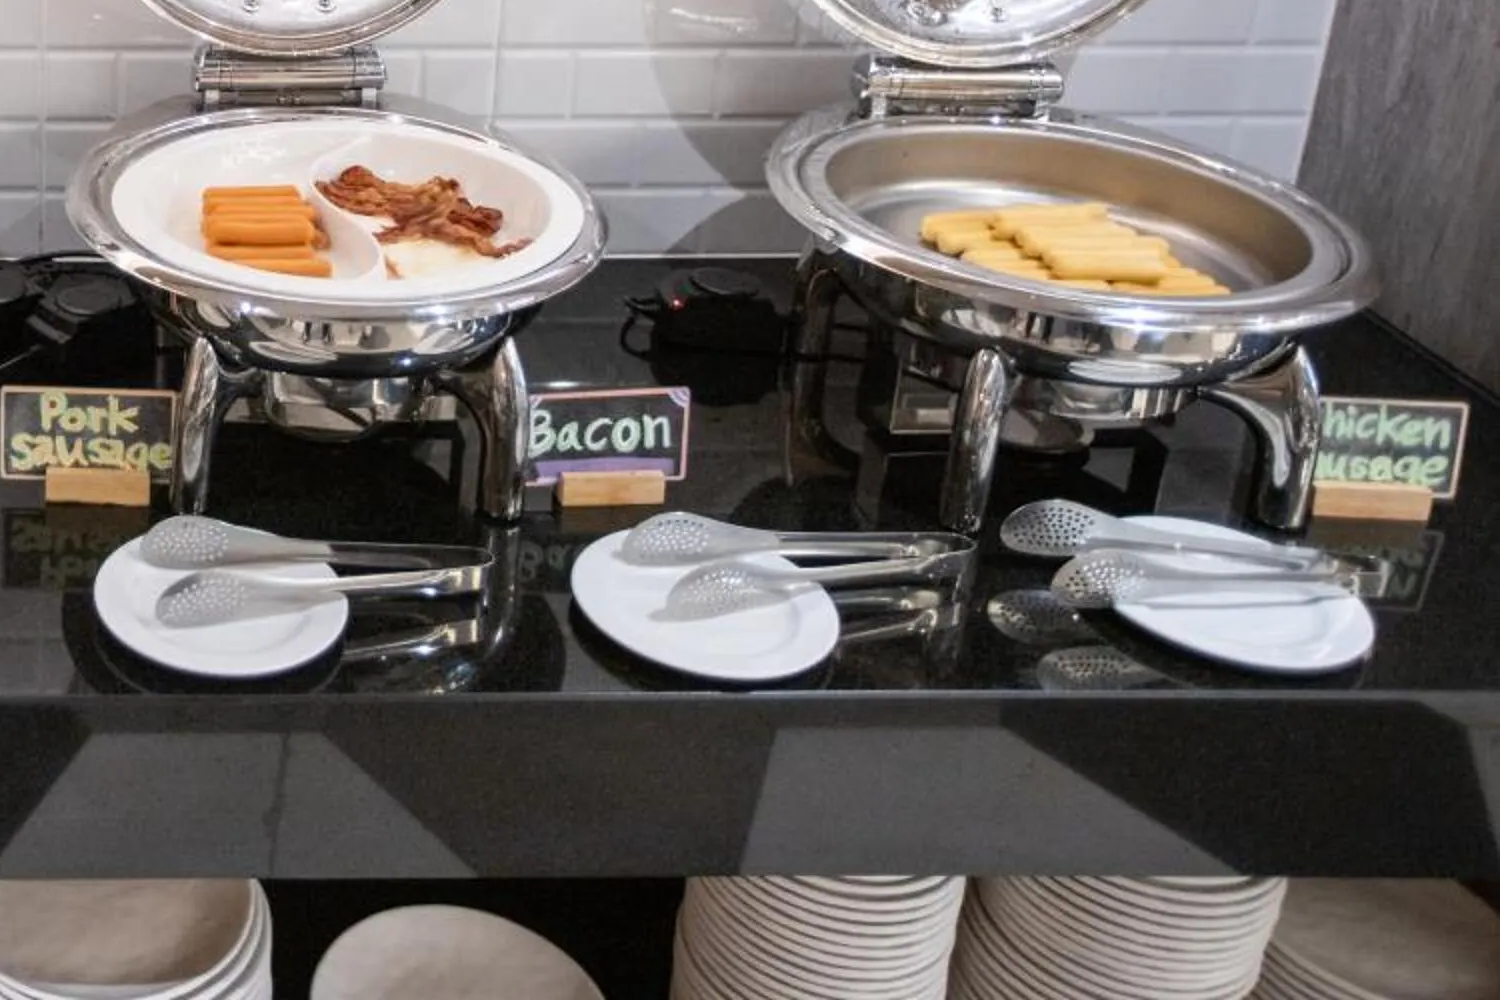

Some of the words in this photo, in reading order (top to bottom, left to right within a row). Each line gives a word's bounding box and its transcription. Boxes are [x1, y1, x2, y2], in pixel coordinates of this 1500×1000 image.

[40, 390, 142, 437] Pork
[527, 408, 673, 459] Bacon
[1323, 401, 1451, 449] hicken
[10, 431, 173, 472] Sausage
[1315, 450, 1449, 486] usage
